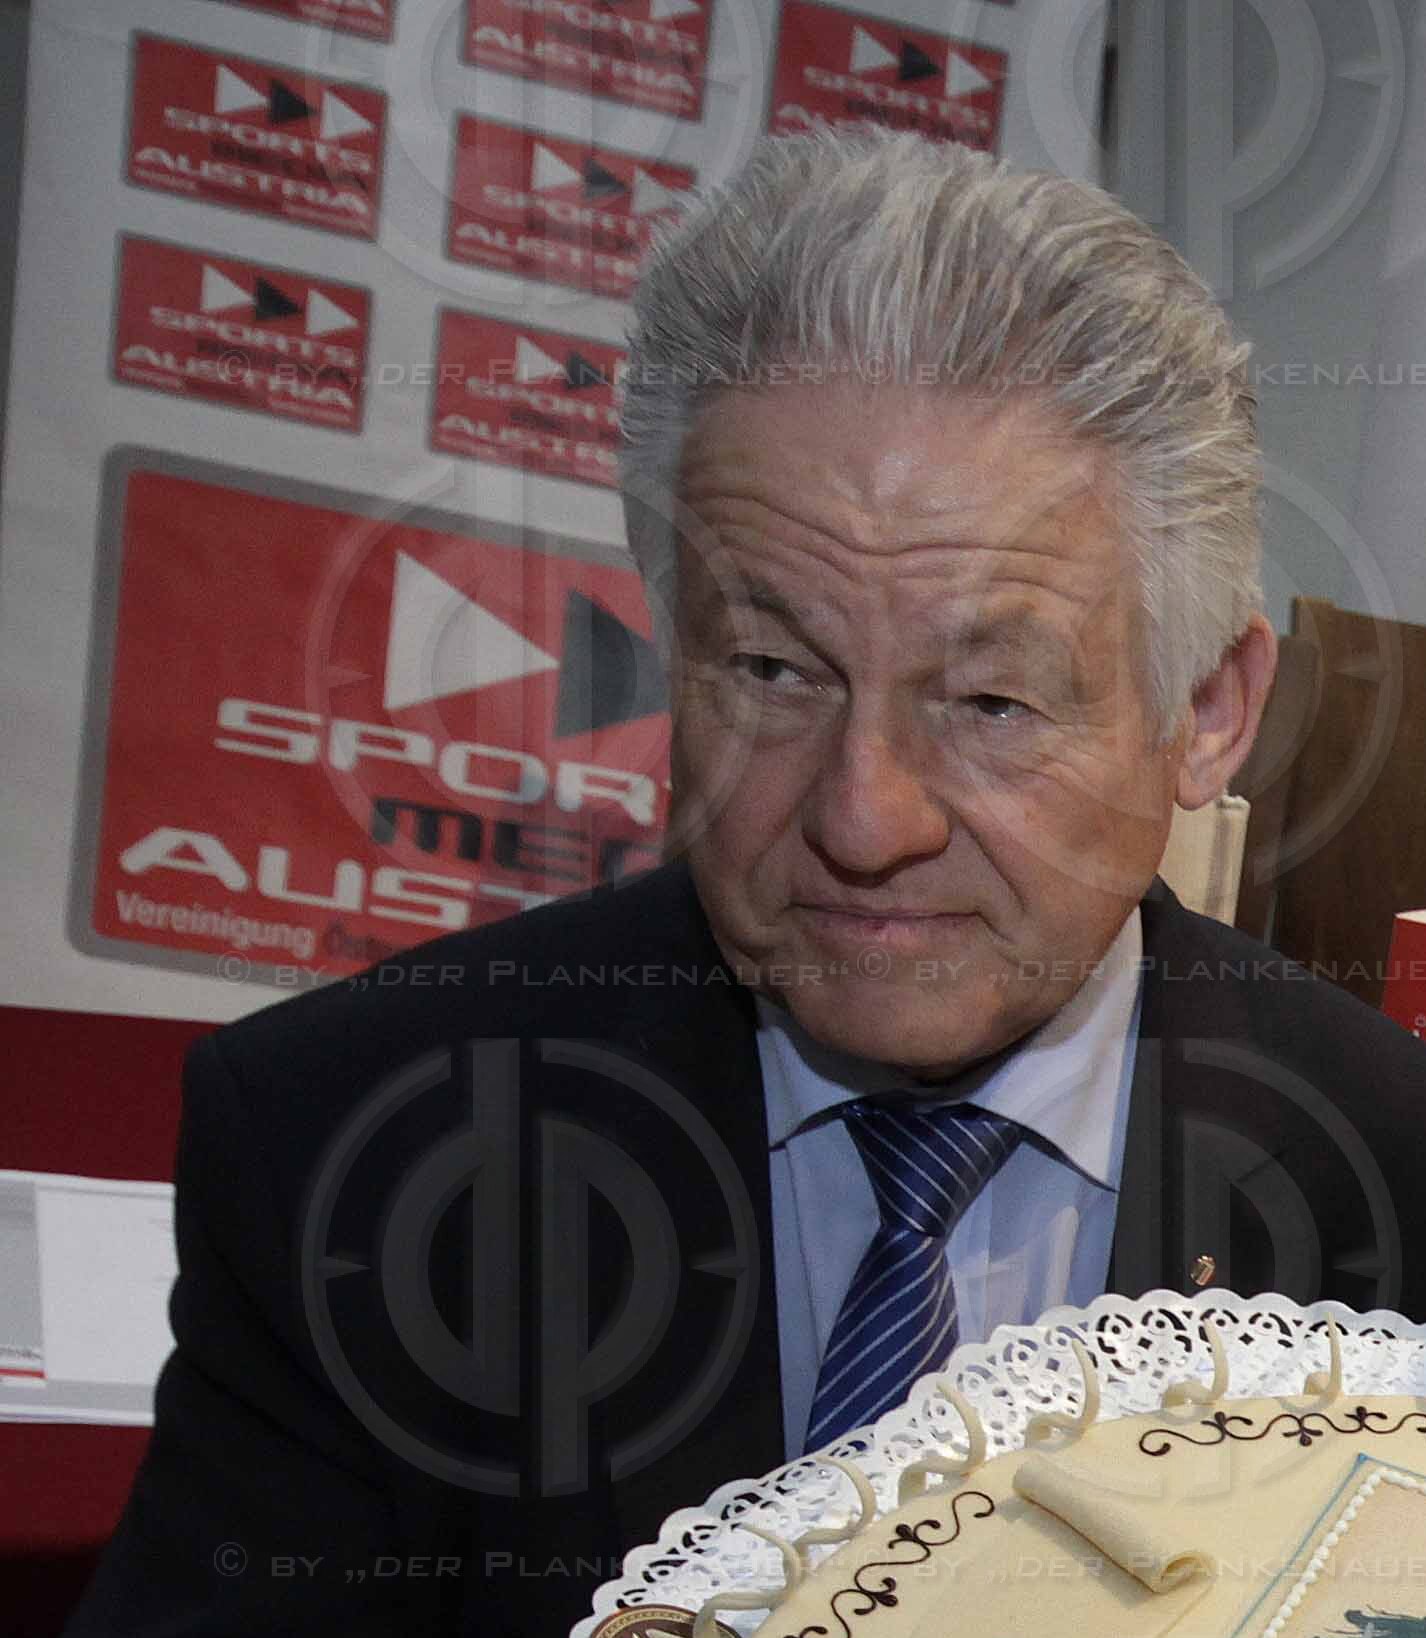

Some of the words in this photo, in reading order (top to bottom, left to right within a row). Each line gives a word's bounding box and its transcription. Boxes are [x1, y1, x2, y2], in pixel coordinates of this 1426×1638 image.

[164, 105, 371, 172] SPORTS
[134, 147, 367, 213] AUSTRIA
[150, 305, 356, 368] SPORTS
[122, 345, 352, 408] AUSTRIA
[214, 697, 671, 826] SPOR
[116, 889, 317, 960] Vereinigung
